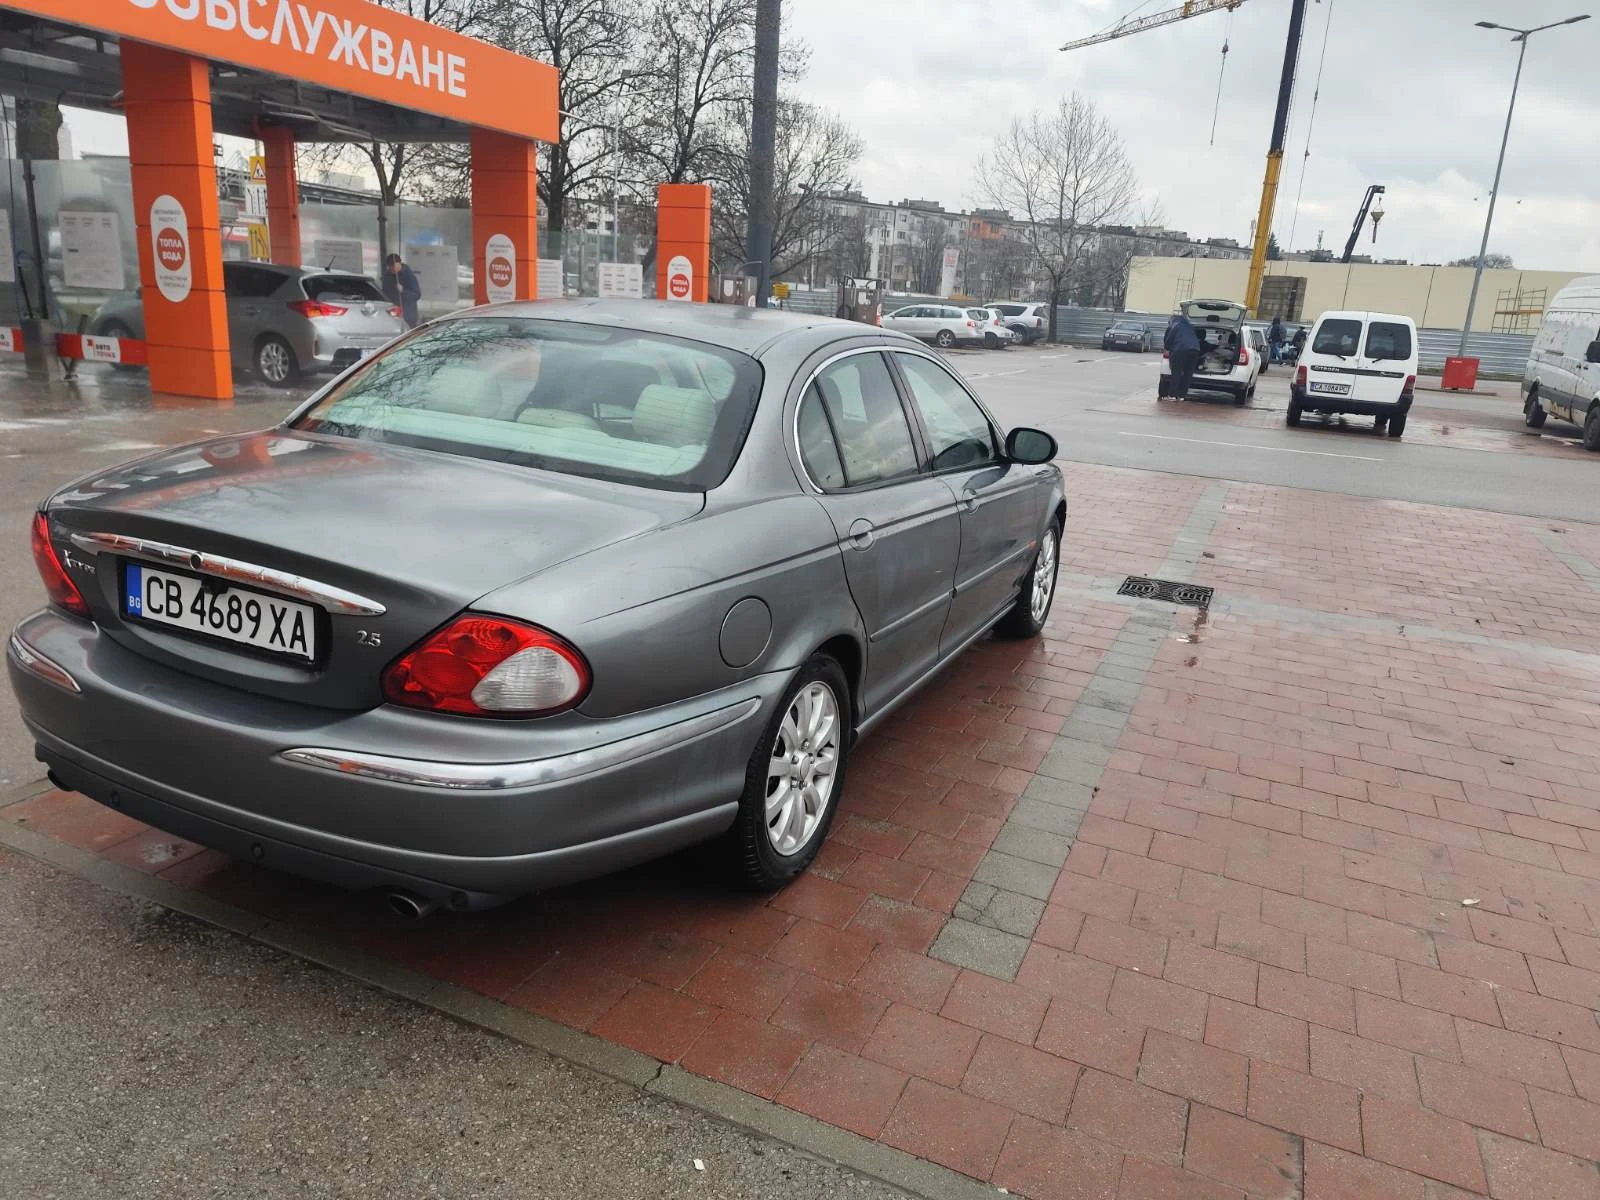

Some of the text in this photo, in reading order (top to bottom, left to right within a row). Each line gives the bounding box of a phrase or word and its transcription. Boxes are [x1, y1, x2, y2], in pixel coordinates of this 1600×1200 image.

[127, 0, 467, 98] БСЛУЖВАНЕ
[159, 238, 182, 249] ТОПЛА
[162, 250, 182, 261] ВОДА
[128, 595, 141, 609] BG
[146, 575, 308, 653] CB 4689 XA
